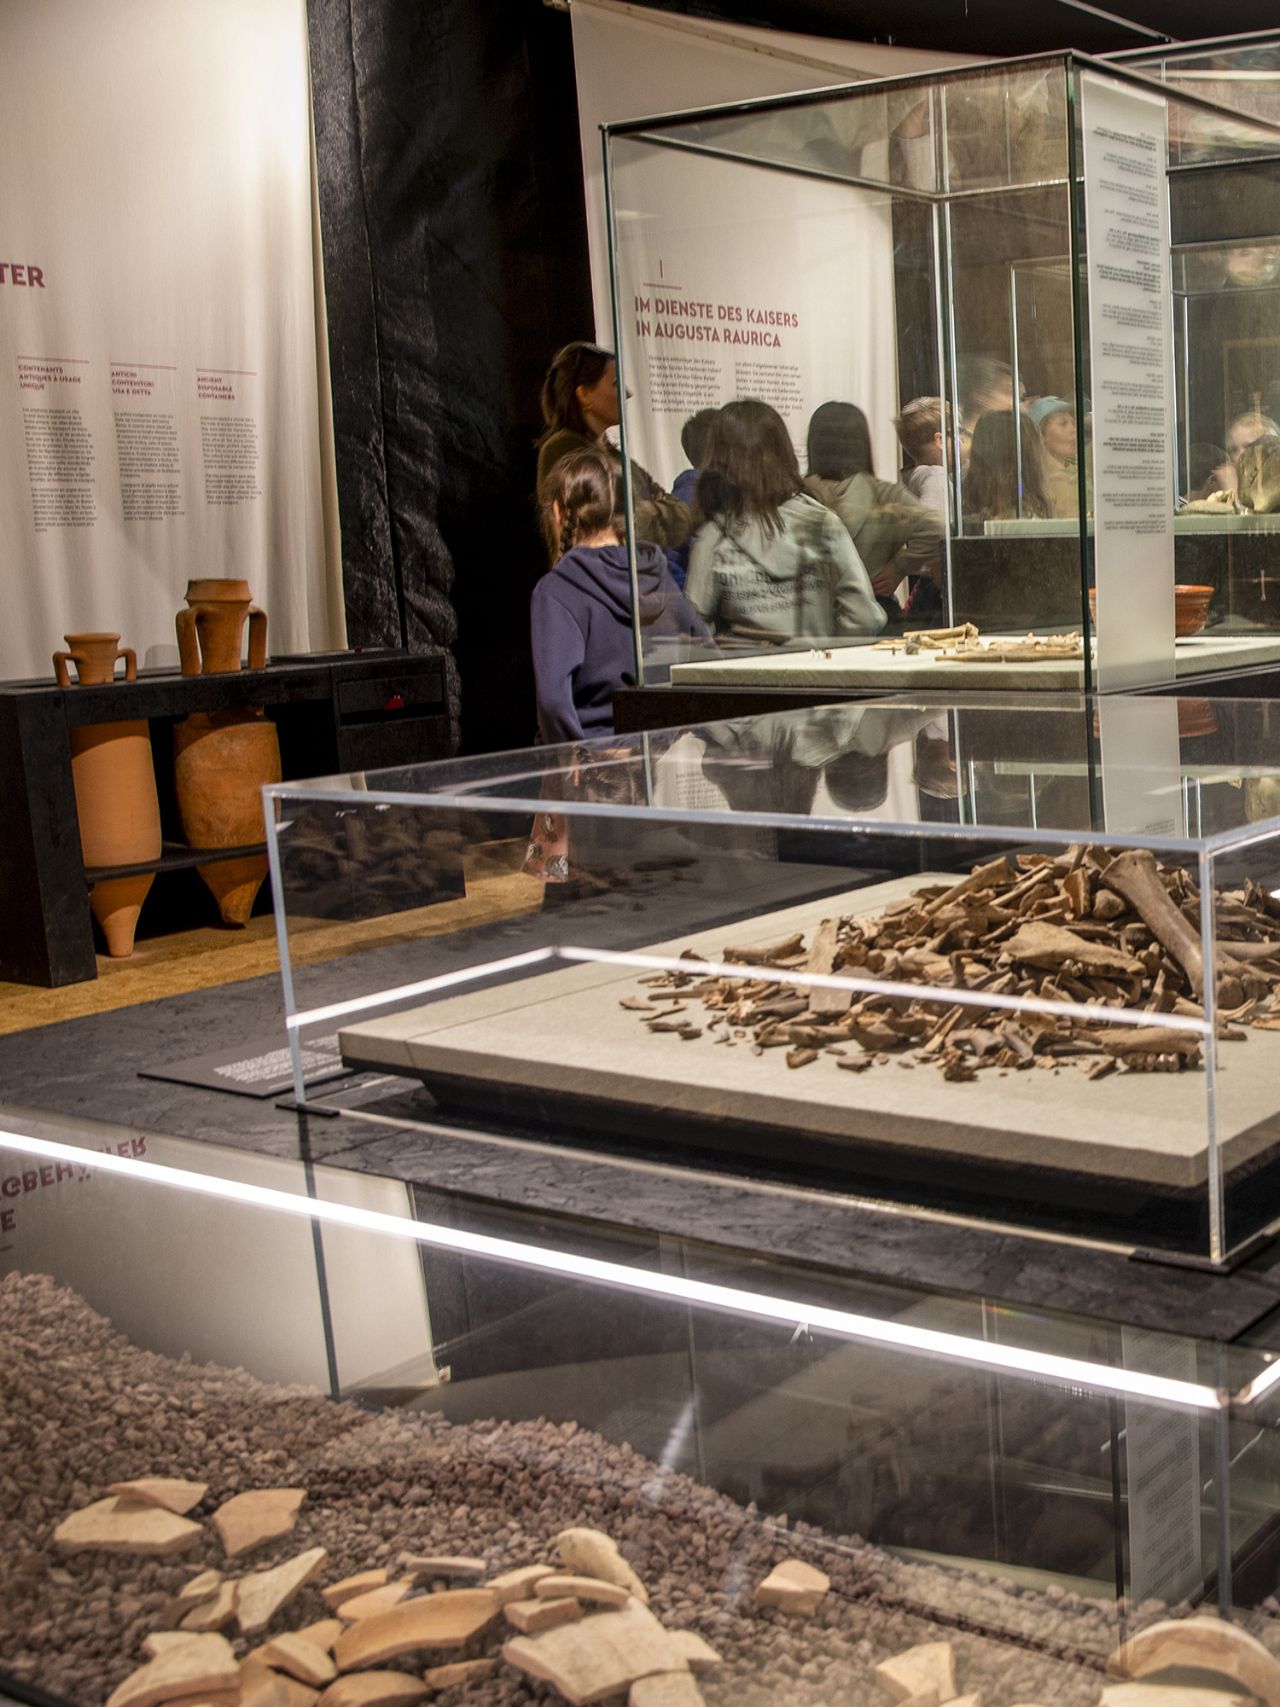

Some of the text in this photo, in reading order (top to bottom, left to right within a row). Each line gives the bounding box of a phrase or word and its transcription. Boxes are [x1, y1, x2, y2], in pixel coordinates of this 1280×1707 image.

[0, 262, 45, 288] TER
[635, 296, 798, 328] IM DIENSTE DES KAISERS
[636, 320, 781, 348] IN AUGUSTA RAURICA
[19, 374, 52, 384] ANTIQUES
[60, 376, 81, 384] USAGE
[20, 382, 45, 392] UNIQUE
